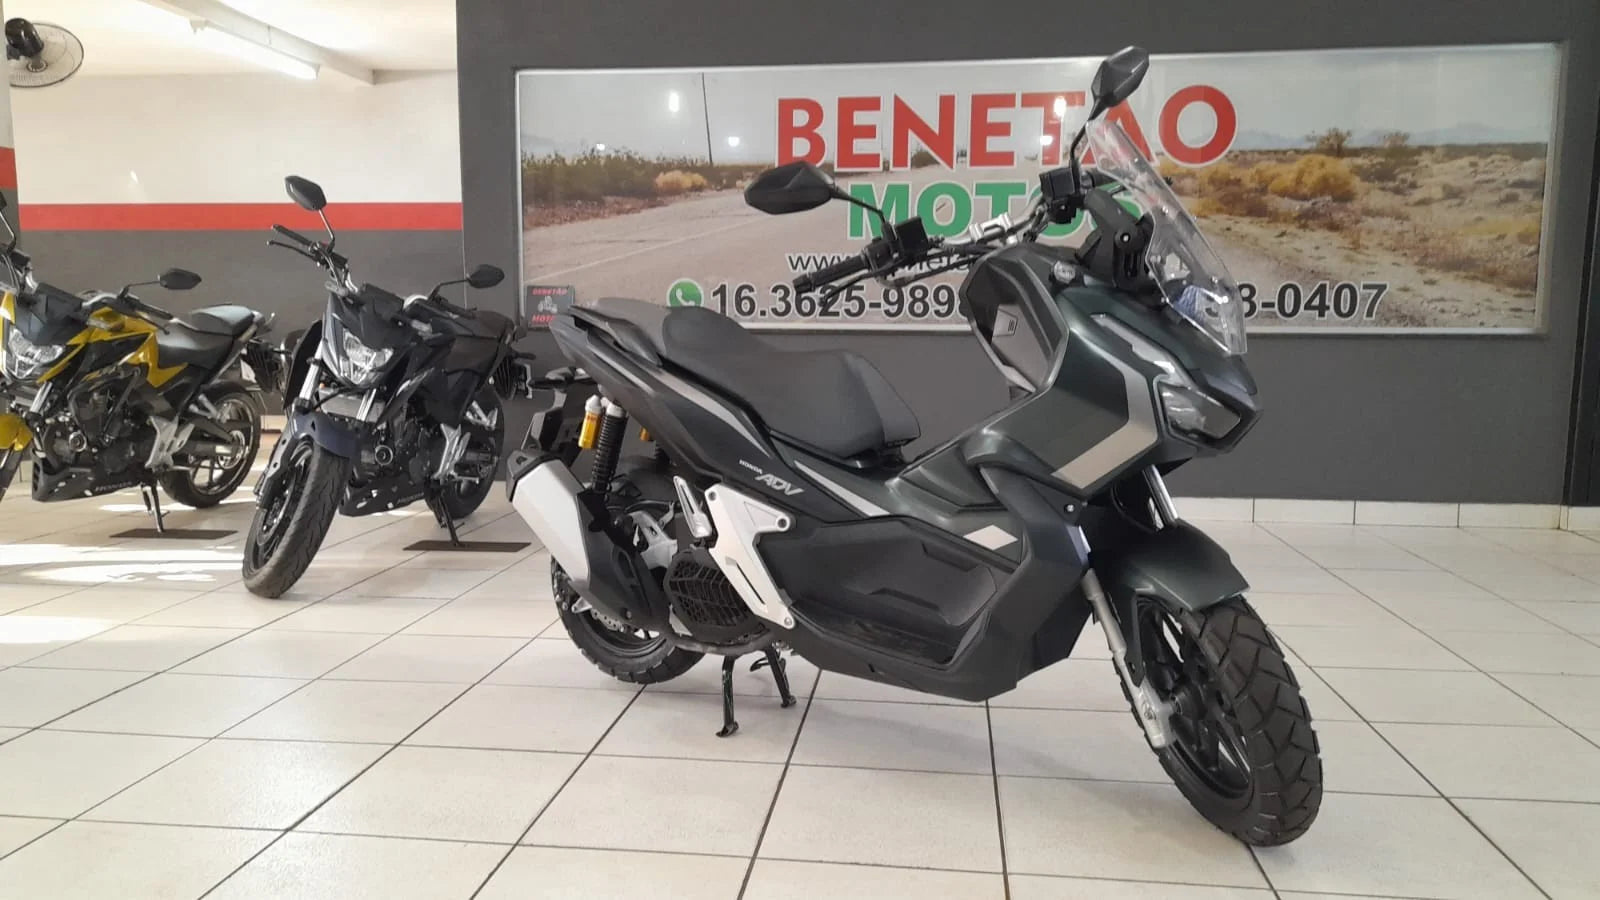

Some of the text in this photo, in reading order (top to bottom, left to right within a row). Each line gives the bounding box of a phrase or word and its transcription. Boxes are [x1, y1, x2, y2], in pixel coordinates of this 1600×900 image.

[711, 283, 968, 318] 16.3625-989
[738, 459, 763, 474] HONDA
[754, 473, 804, 496] ADV
